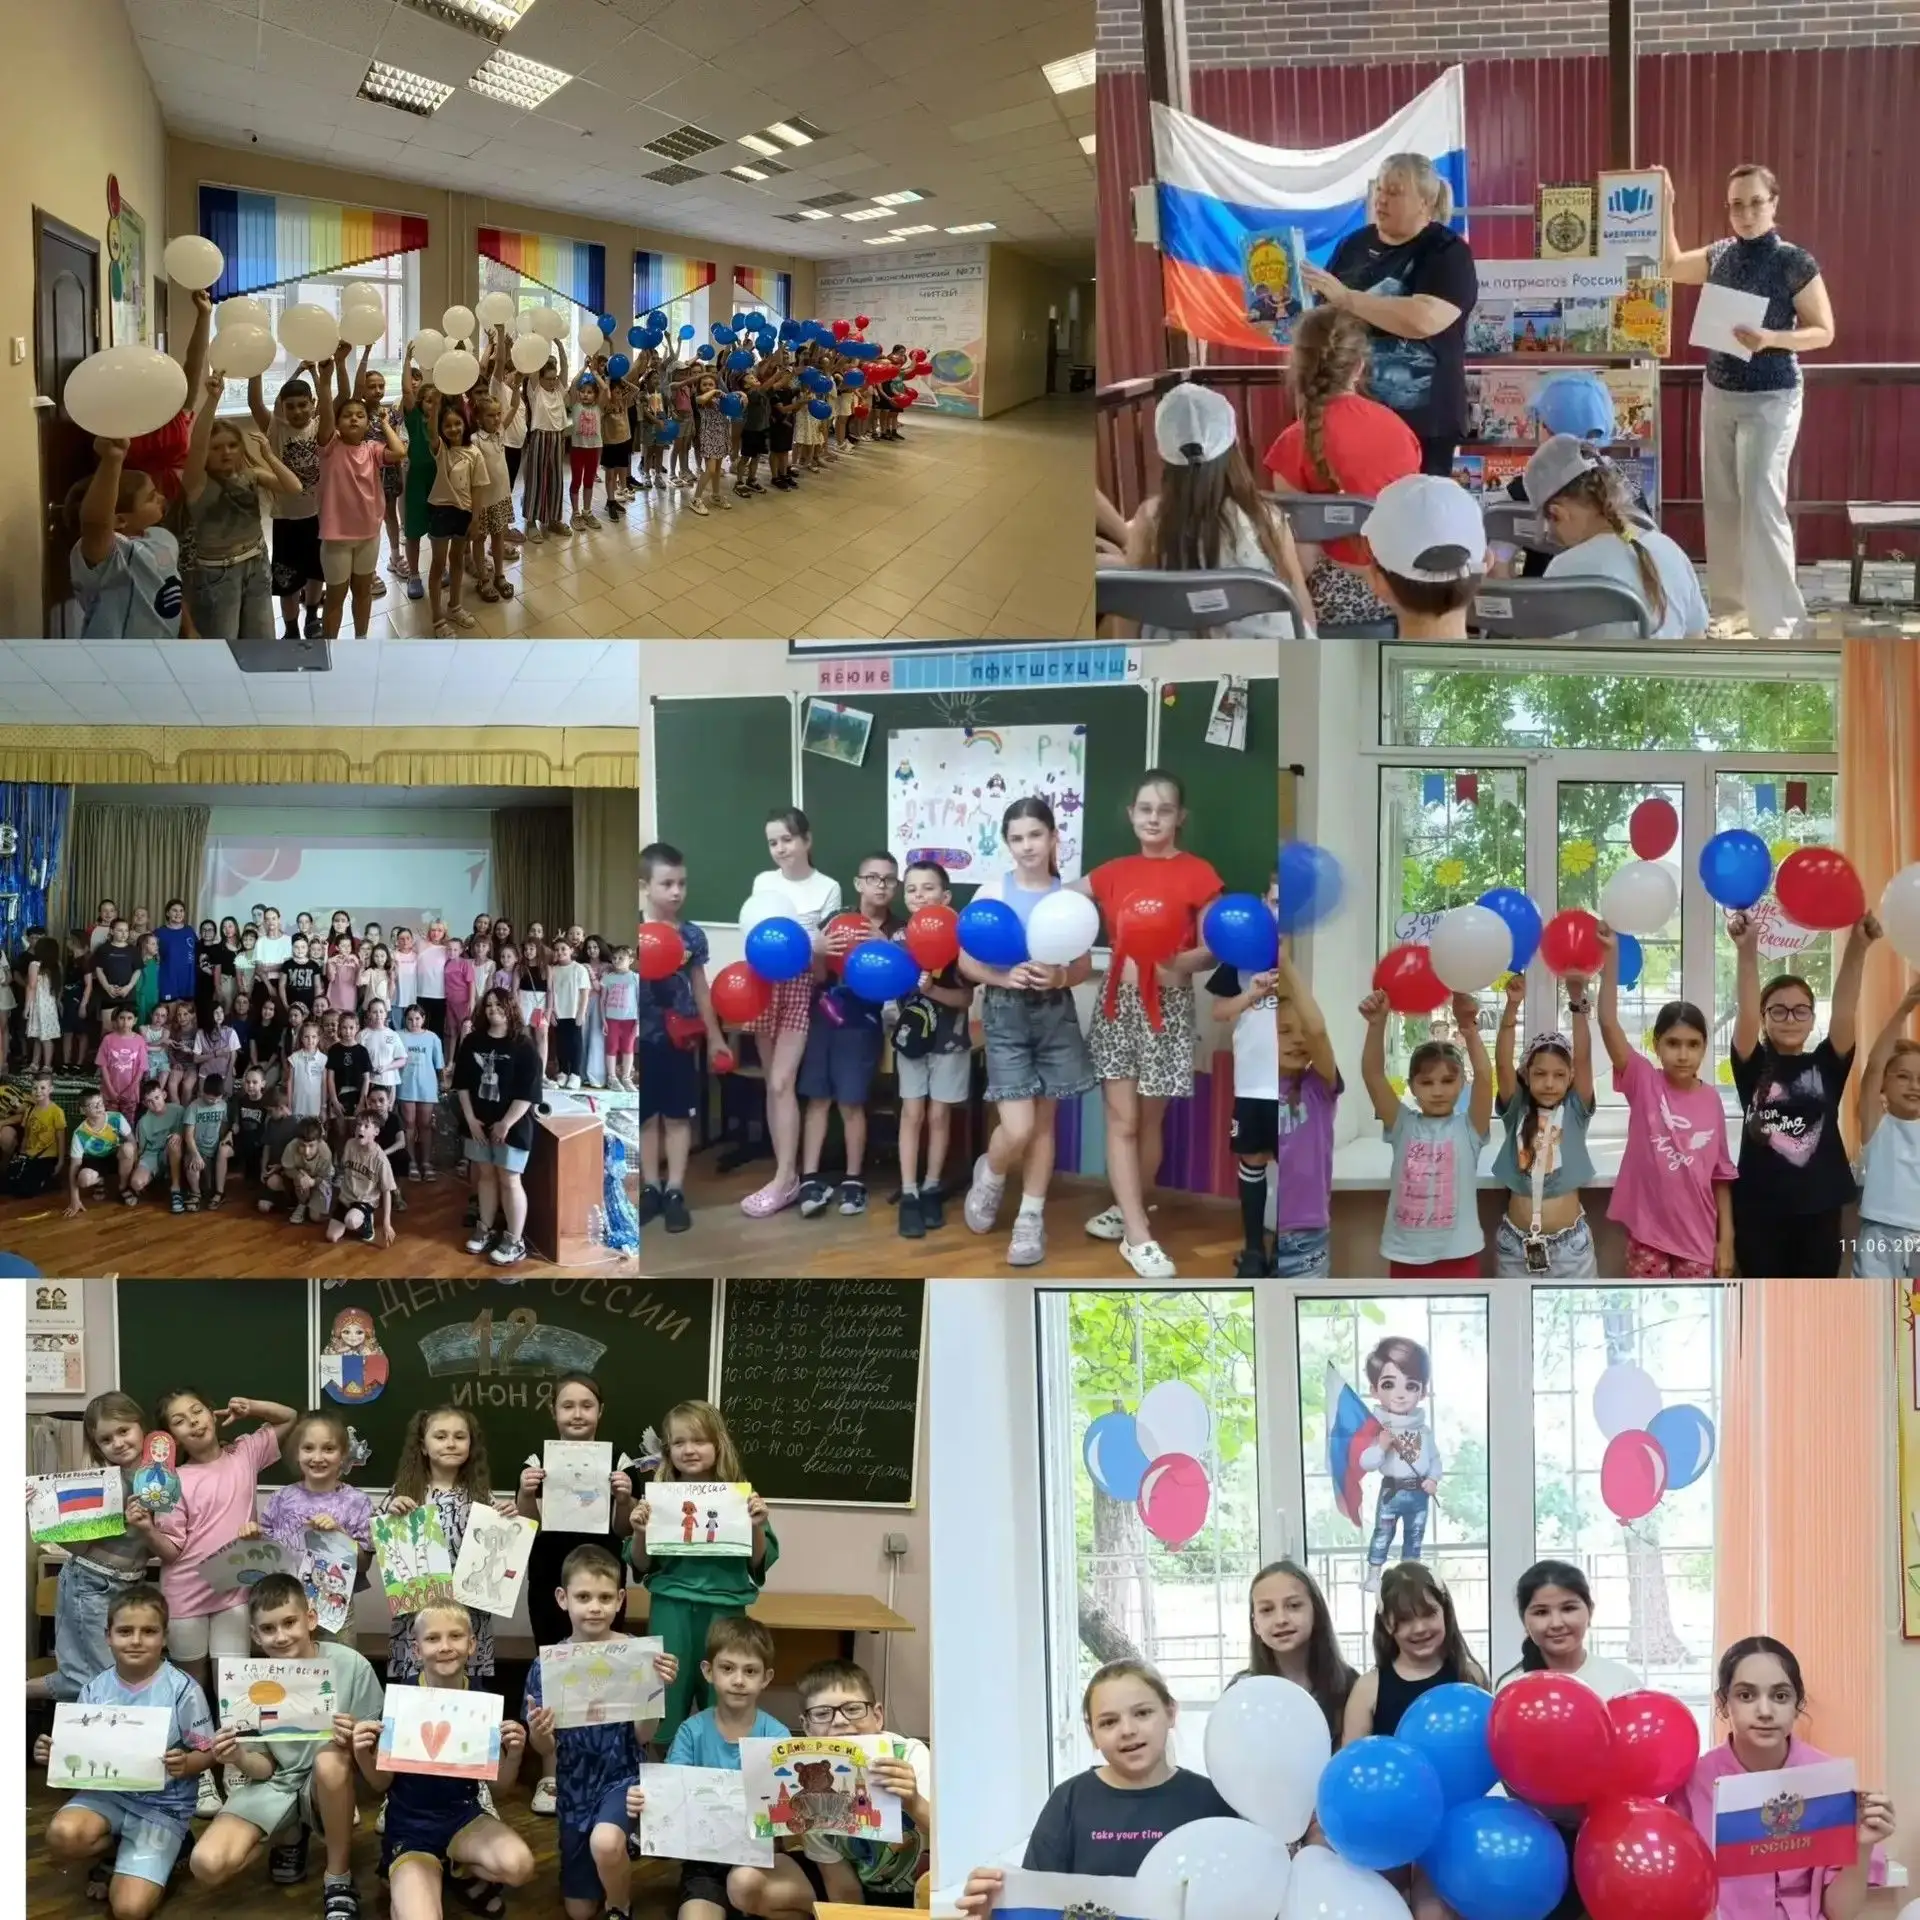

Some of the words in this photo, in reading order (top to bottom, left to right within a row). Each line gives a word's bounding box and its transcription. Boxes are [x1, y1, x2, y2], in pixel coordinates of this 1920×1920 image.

[1573, 273, 1624, 287] России
[451, 1380, 553, 1411] ИЮНЯ
[1091, 1830, 1114, 1840] take
[1116, 1831, 1140, 1841] your
[1749, 1836, 1811, 1857] РОССИЯ
